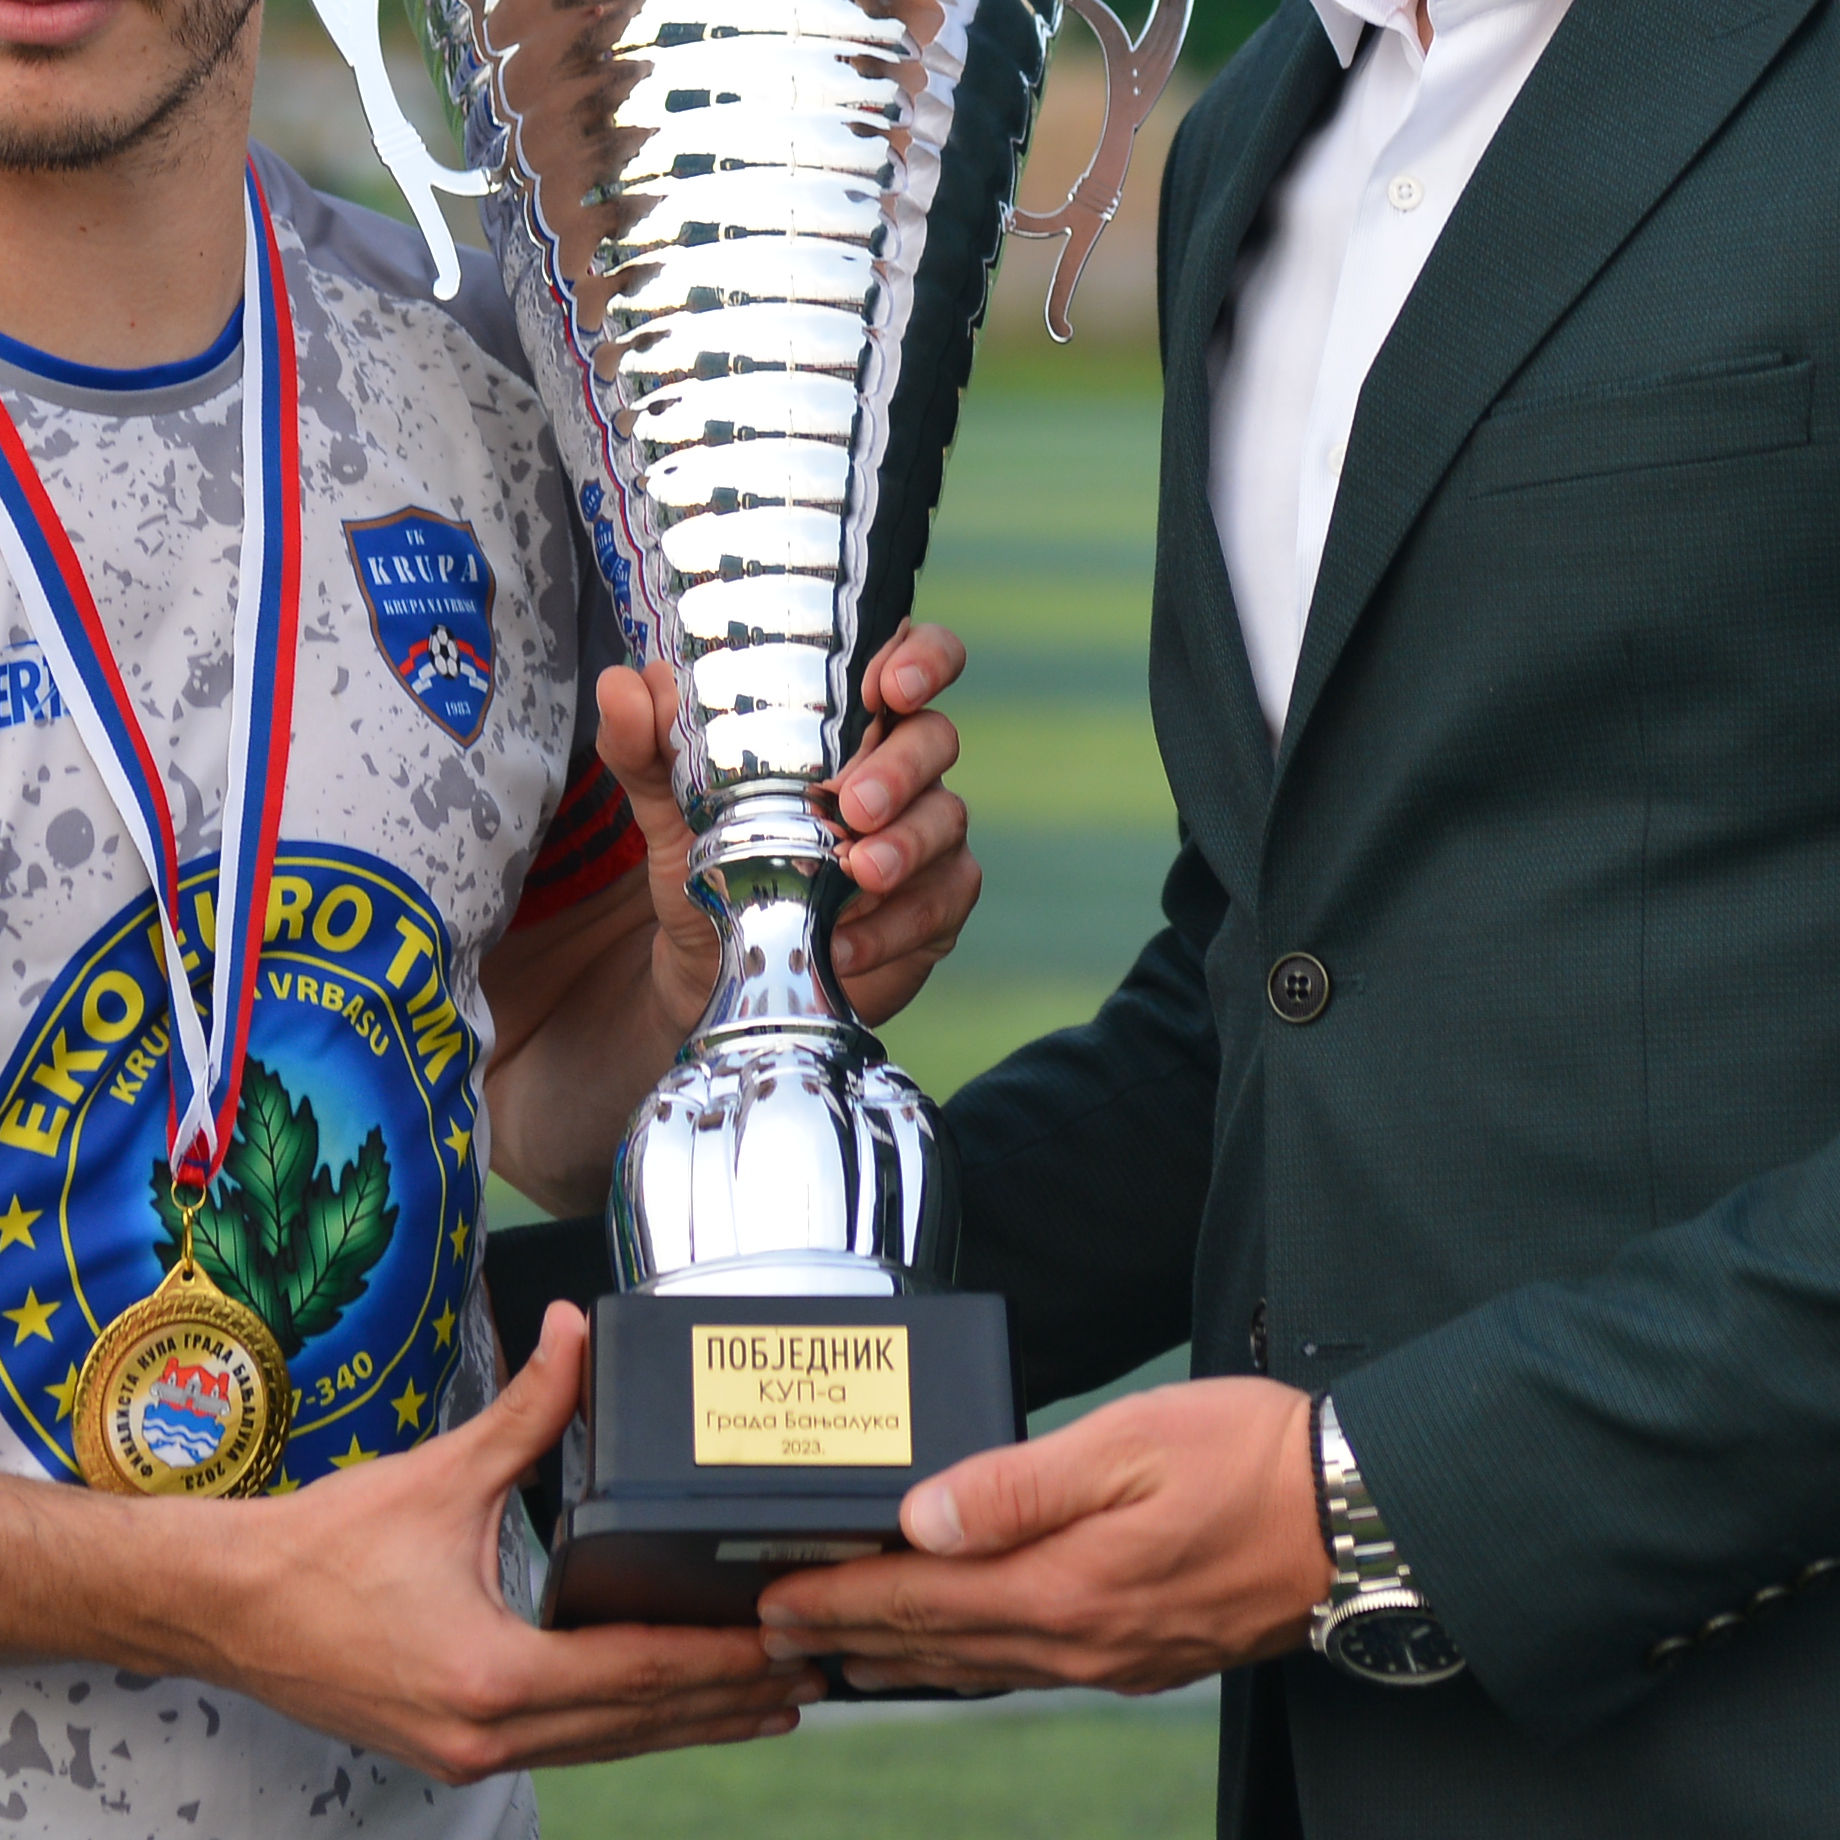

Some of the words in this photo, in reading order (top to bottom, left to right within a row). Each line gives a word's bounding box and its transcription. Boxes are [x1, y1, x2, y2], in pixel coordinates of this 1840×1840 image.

[405, 529, 425, 546] FK
[367, 553, 479, 585] KRUPA
[383, 597, 426, 615] KRUPA
[445, 701, 471, 717] 1983
[385, 914, 463, 1086] TIM
[268, 971, 390, 1056] VRBASU
[707, 1336, 894, 1376] ПОБЈЕДНИК
[759, 1379, 847, 1404] КУП-а
[116, 1373, 153, 1478] ФИНАЛИСТА
[137, 1336, 177, 1370] КУПА
[184, 1333, 233, 1364] ГРАДА
[707, 1411, 777, 1433] Града
[785, 1411, 899, 1434] Бањалука
[782, 1440, 825, 1455] 2023.
